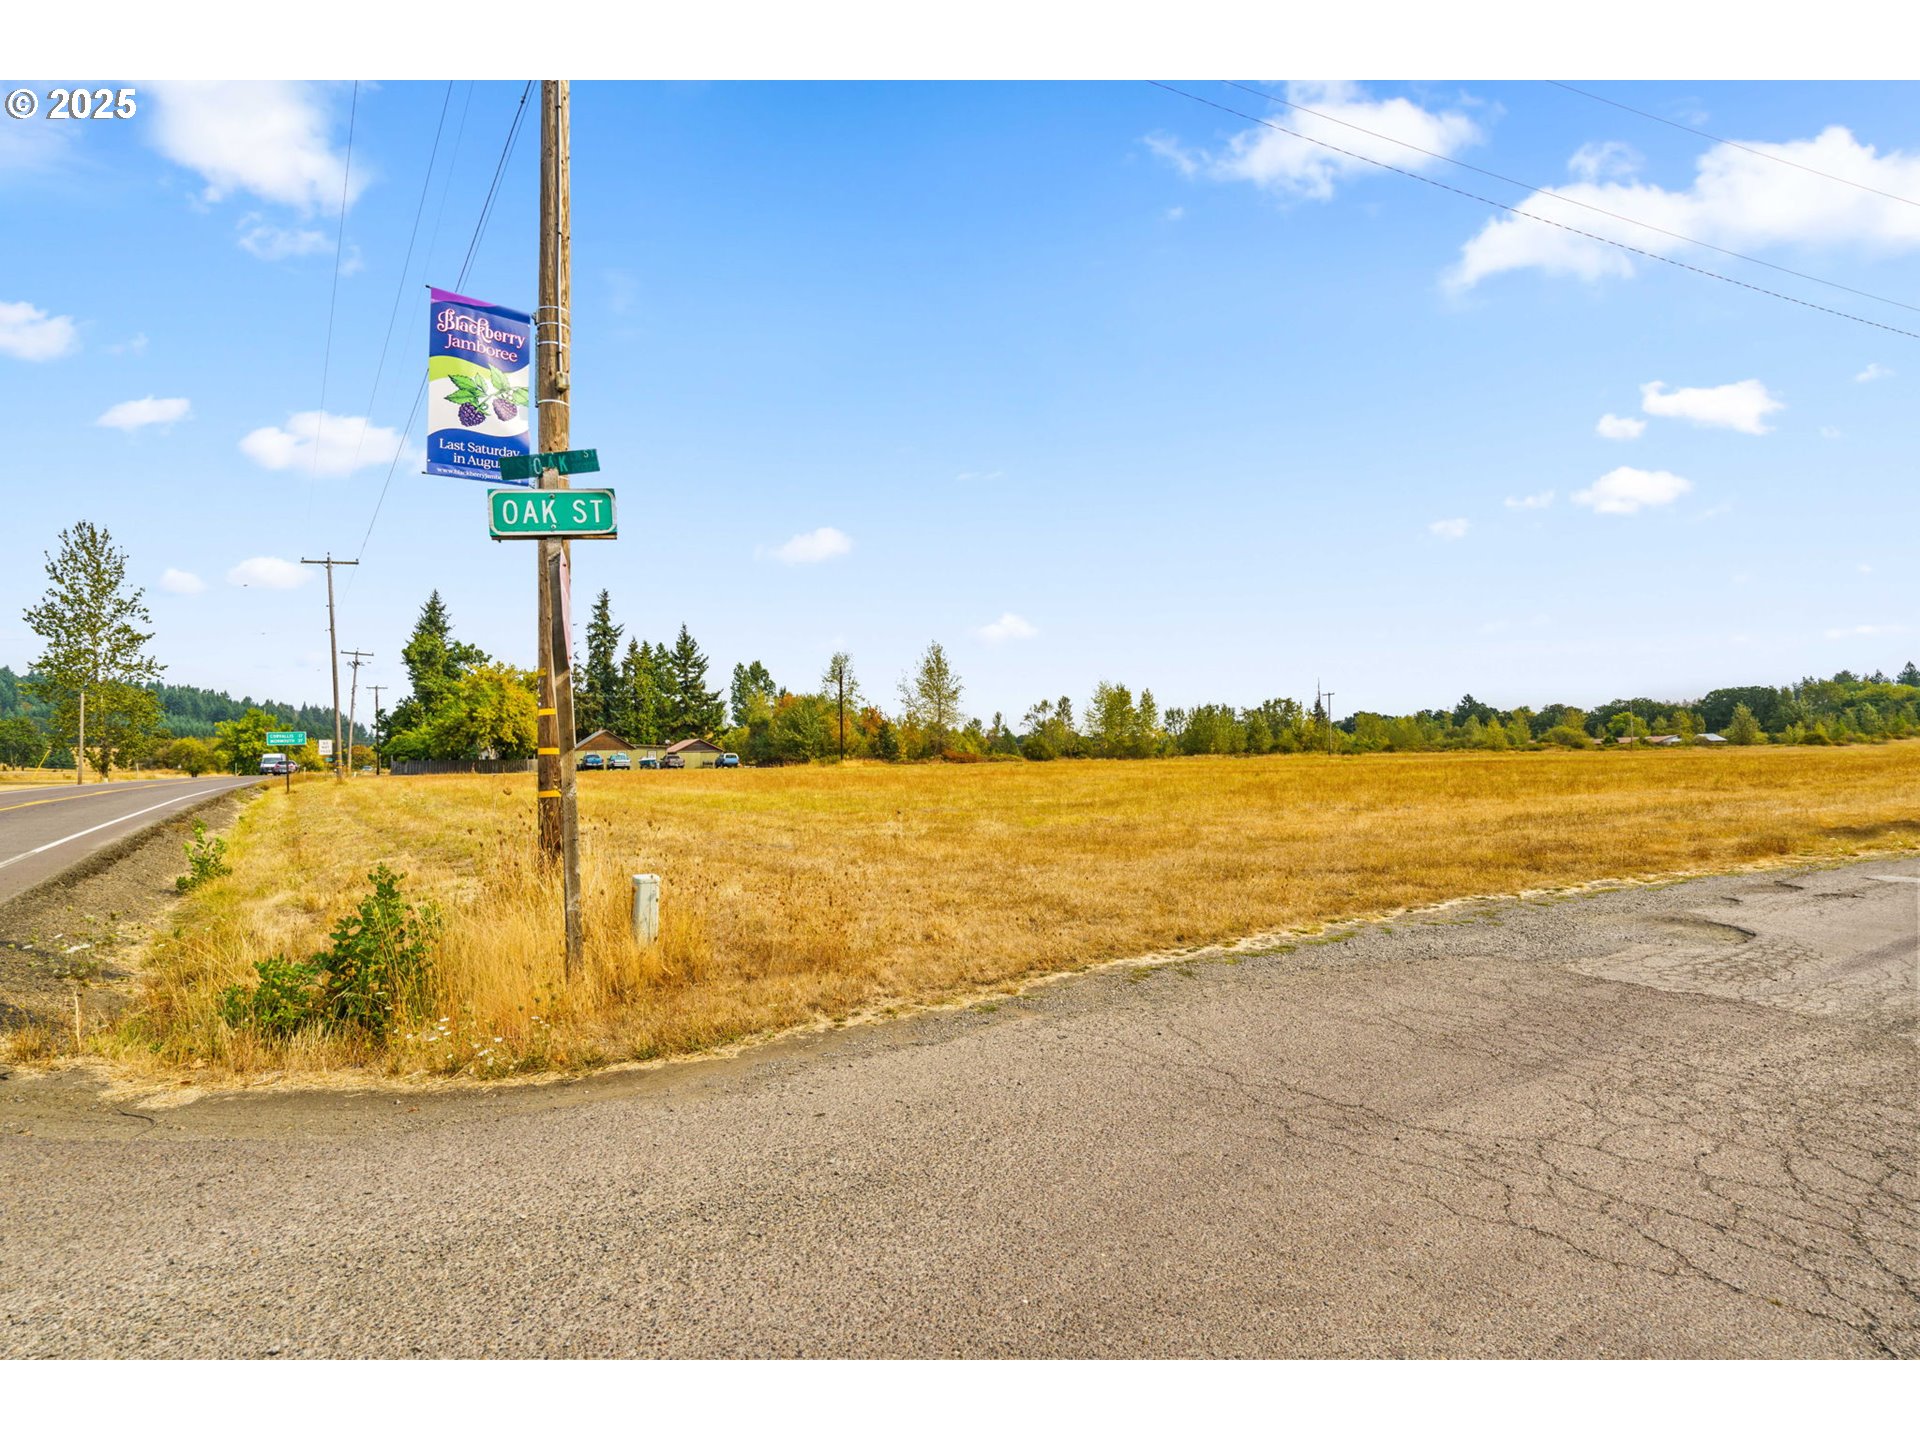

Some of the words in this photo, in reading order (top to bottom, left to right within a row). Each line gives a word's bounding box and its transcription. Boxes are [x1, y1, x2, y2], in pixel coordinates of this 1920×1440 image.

[437, 308, 526, 349] Blackberry
[444, 333, 518, 363] Jamboree
[439, 438, 465, 451] Last
[467, 441, 520, 457] Saturday
[453, 453, 466, 464] in
[467, 455, 501, 470] Augu
[533, 455, 568, 475] OAK
[502, 499, 558, 525] OAK
[572, 499, 604, 524] ST
